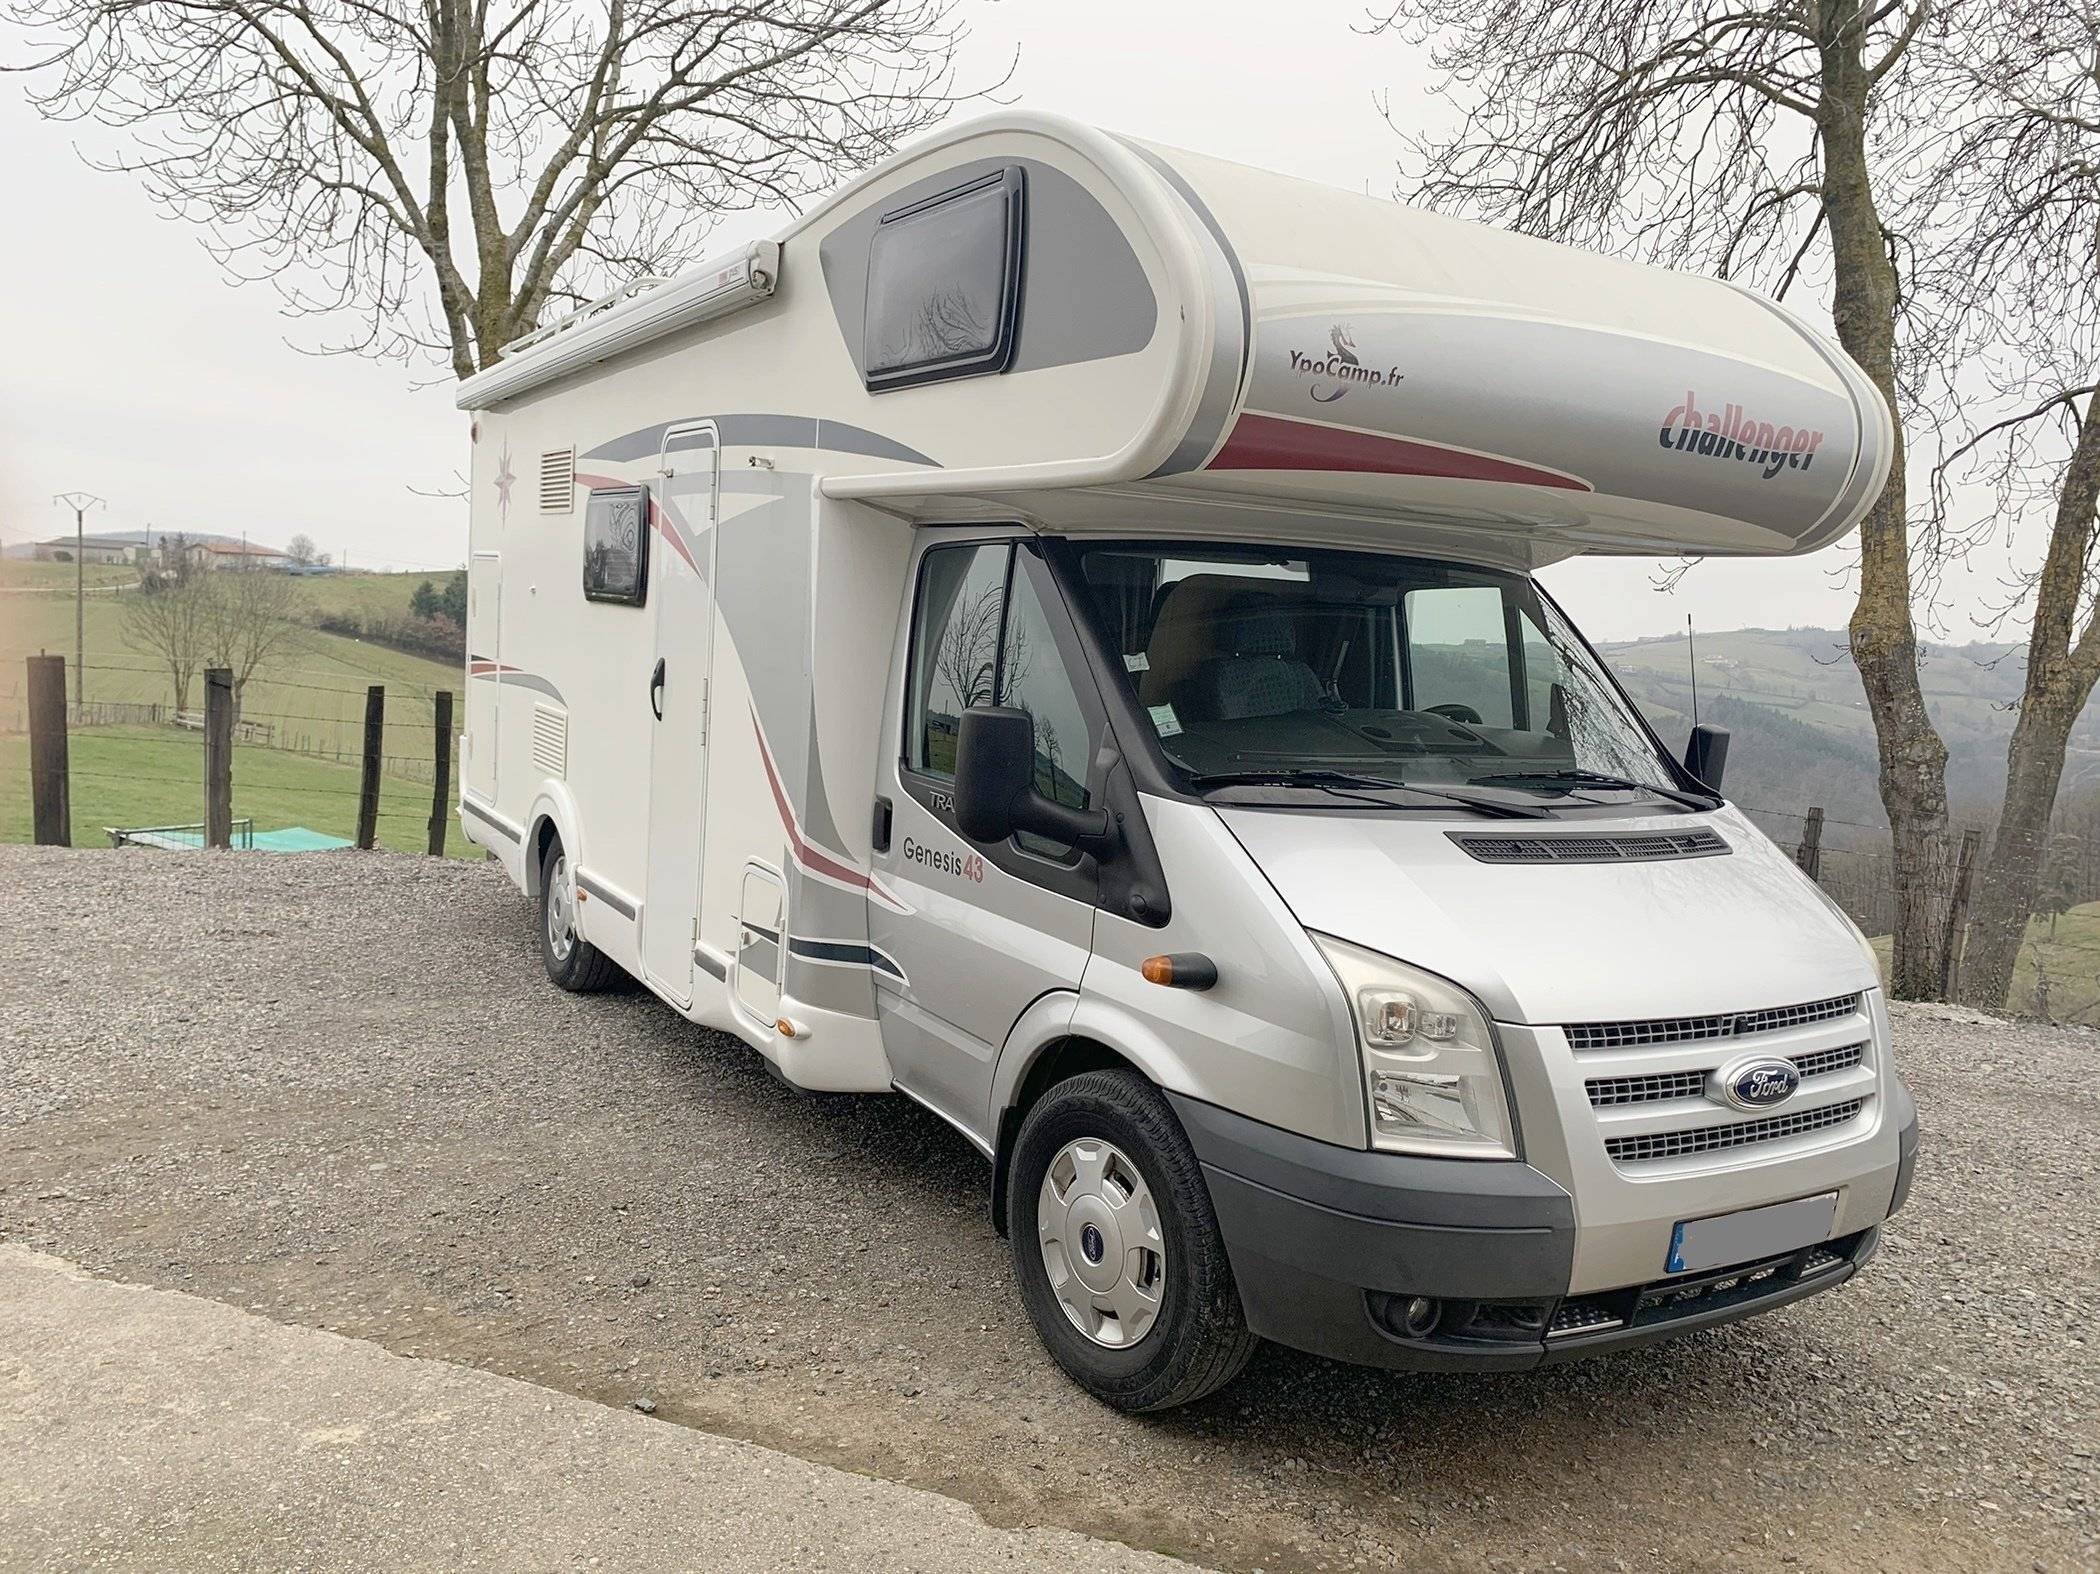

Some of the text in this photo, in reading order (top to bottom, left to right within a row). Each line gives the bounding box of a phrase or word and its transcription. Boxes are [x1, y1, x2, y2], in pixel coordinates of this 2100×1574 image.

[1290, 350, 1404, 389] YpoCamp.fr
[1659, 390, 1823, 479] challenger
[1749, 1069, 1789, 1098] Ford
